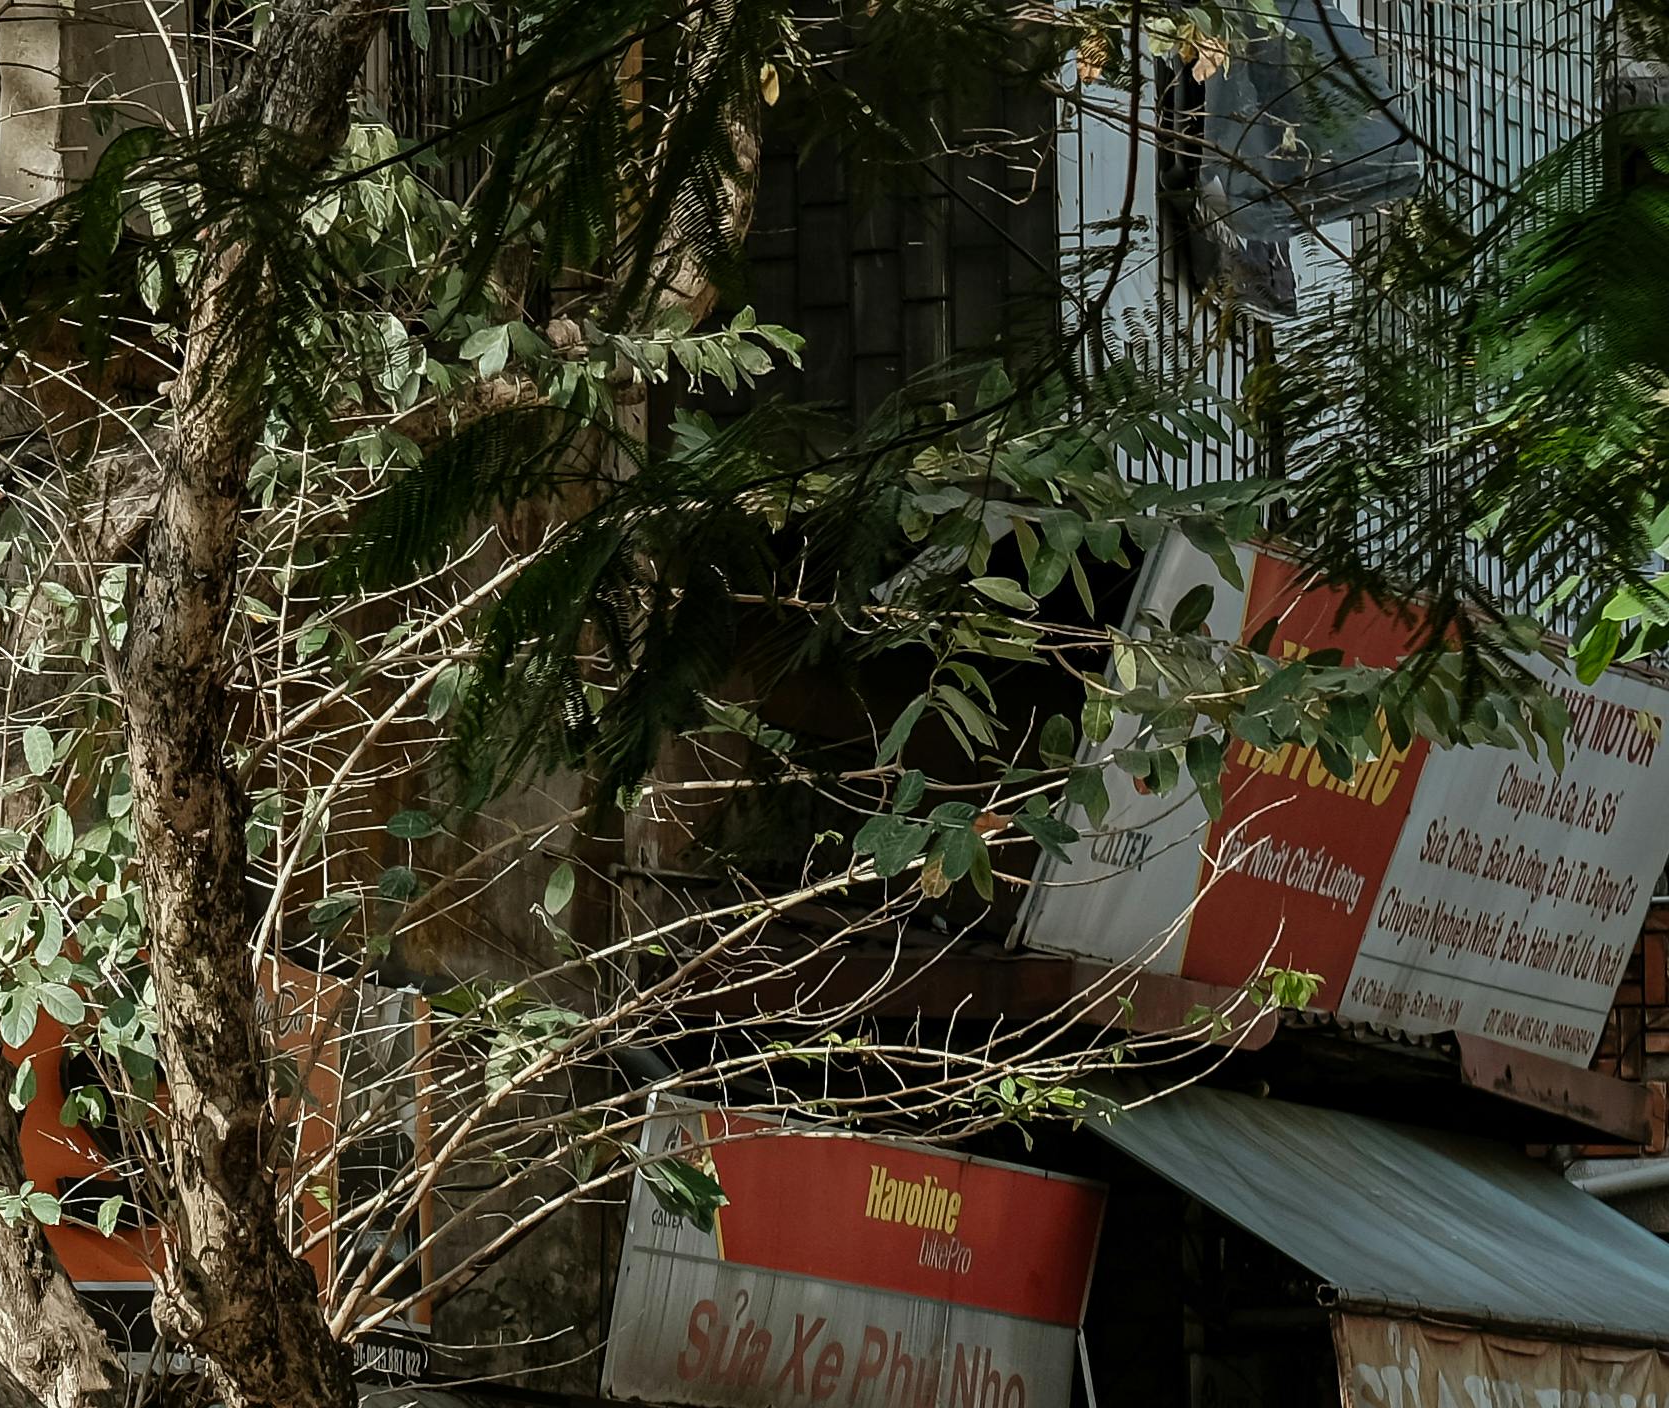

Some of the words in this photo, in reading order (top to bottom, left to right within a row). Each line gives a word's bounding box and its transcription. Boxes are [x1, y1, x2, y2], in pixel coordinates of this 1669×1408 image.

[1090, 832, 1152, 873] CALTEX
[866, 1164, 962, 1235] Havoline
[918, 1231, 972, 1275] bikePro
[676, 1288, 773, 1388] Sửa
[774, 1312, 844, 1401] Xe
